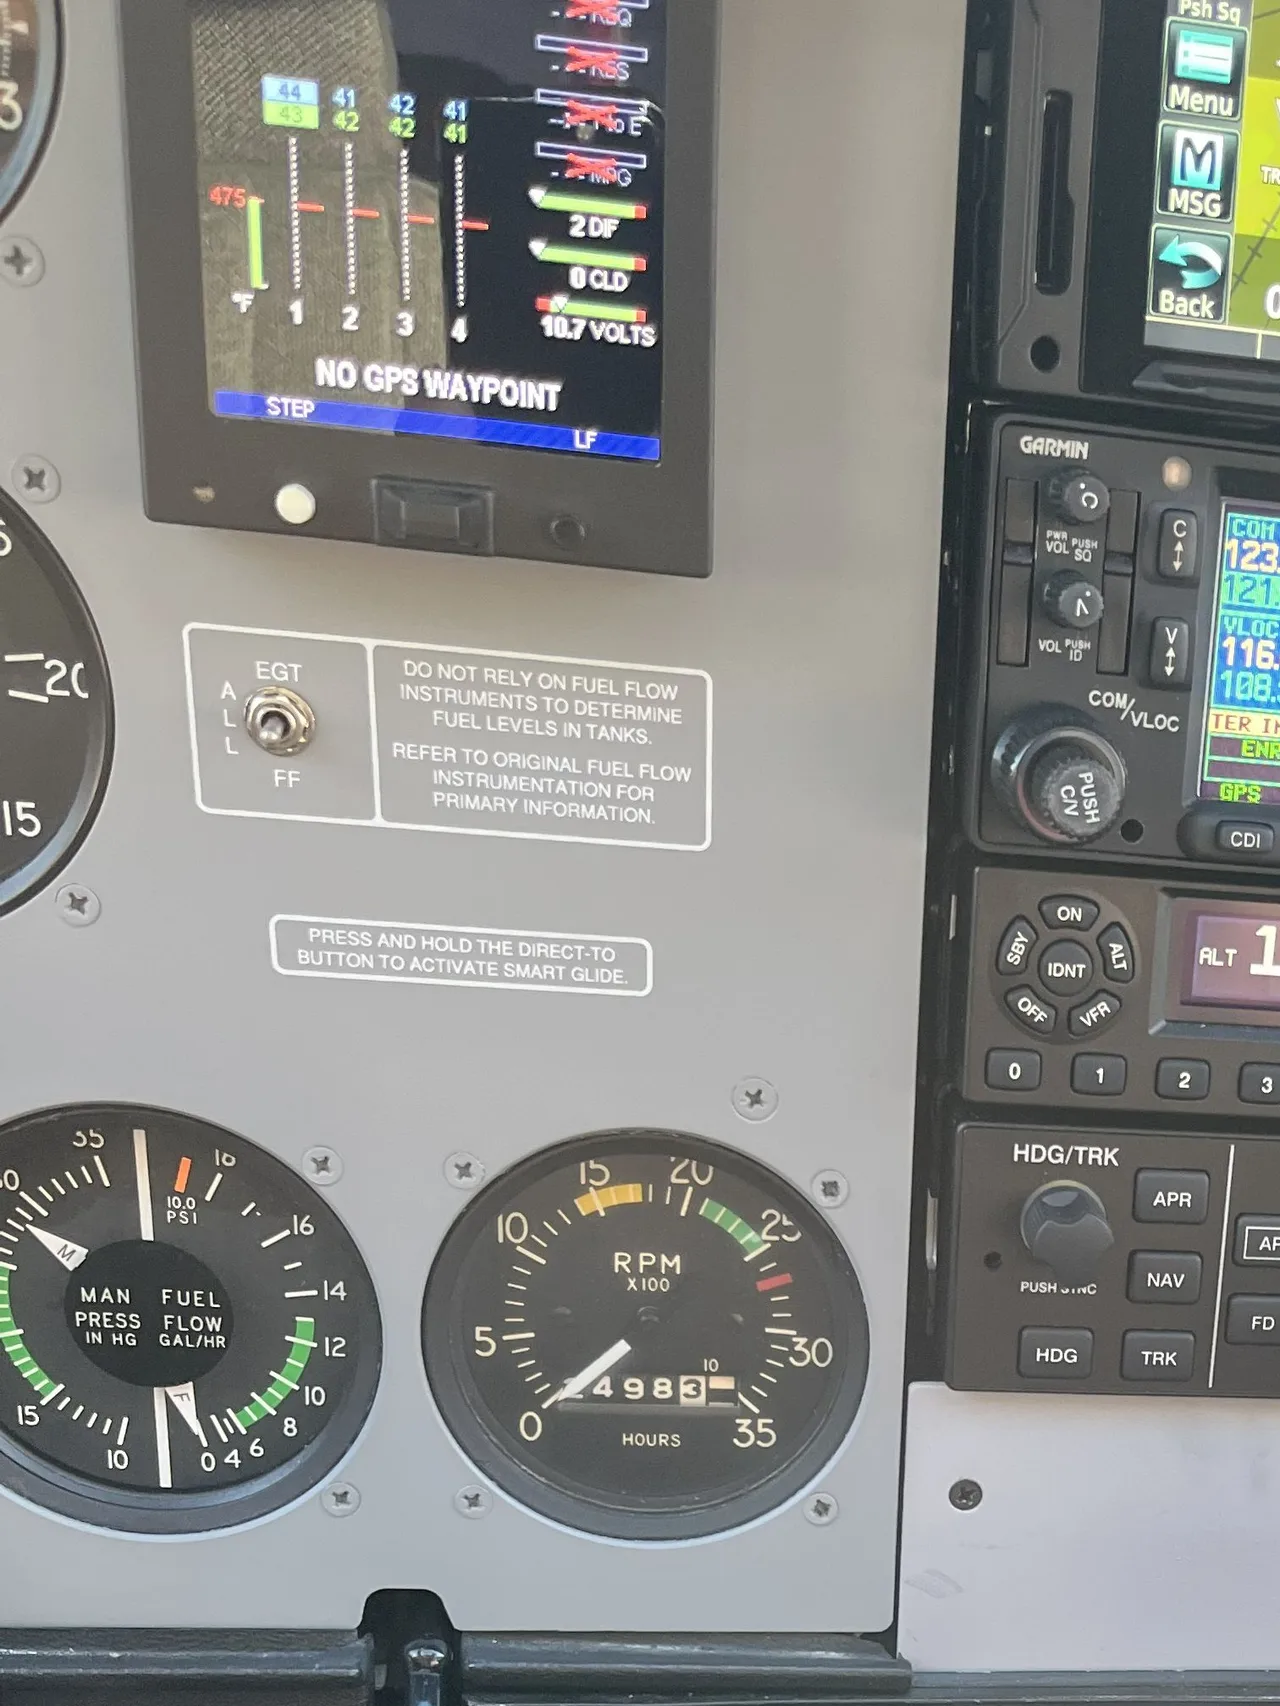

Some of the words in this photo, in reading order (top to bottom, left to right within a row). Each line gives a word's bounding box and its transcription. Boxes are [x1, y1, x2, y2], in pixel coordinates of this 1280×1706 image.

[1169, 85, 1233, 116] Menu
[1168, 189, 1221, 218] MSG
[1159, 291, 1214, 319] Back
[317, 360, 358, 390] NO
[365, 364, 418, 398] GPS
[424, 370, 561, 412] WAYPOINT
[267, 397, 314, 418] STEP
[1020, 435, 1089, 460] GARMIN
[257, 661, 302, 682] EGT
[404, 660, 432, 678] DO
[438, 664, 477, 682] NOT
[484, 668, 532, 688] RELY
[538, 672, 566, 692] ON
[572, 676, 619, 696] FUEL
[624, 681, 678, 701] FLOW
[400, 683, 538, 712] INSTRUMENTS
[542, 696, 568, 714] TO
[574, 699, 682, 724] DETERMINE
[433, 710, 481, 730] FUEL
[487, 715, 558, 736] LEVELS
[564, 722, 581, 738] IN
[587, 724, 652, 745] TANKS.
[1213, 712, 1249, 733] TER
[392, 742, 456, 763] REFER
[460, 748, 488, 766] TO
[494, 750, 582, 774] ORIGINAL
[588, 760, 633, 778] FUEL
[639, 764, 692, 782] FLOW
[433, 770, 610, 798] INSTRUMENTATION
[617, 783, 654, 802] FOR
[1219, 783, 1261, 803] GPS
[433, 792, 518, 814] PRIMARY
[524, 798, 656, 824] INFORMATION.
[1231, 832, 1260, 848] CDI
[1057, 906, 1082, 922] ON
[309, 927, 372, 947] PRESS
[378, 932, 417, 950] AND
[421, 936, 472, 954] HOLD
[477, 939, 513, 956] THE
[518, 941, 616, 963] DIRECT-TO
[1007, 931, 1030, 967] SBY
[298, 949, 374, 969] BUTTON
[378, 954, 405, 971] TO
[410, 957, 499, 976] ACTIVATE
[504, 963, 565, 980] SMART
[571, 967, 629, 985] GLIDE.
[1199, 946, 1237, 967] ALT
[1047, 963, 1086, 979] IDNT
[1079, 1000, 1111, 1028] VFR
[1013, 1143, 1120, 1167] HDG/TRK
[1153, 1191, 1192, 1209] APR
[613, 1252, 682, 1275] RPM
[627, 1277, 670, 1293] X100
[1147, 1273, 1185, 1289] NAV
[81, 1287, 130, 1304] MAN
[162, 1289, 220, 1309] FUEL
[75, 1312, 141, 1330] PRESS
[164, 1314, 222, 1332] FLOW
[159, 1334, 226, 1349] GAL/HR
[1035, 1347, 1078, 1364] HDG
[1141, 1351, 1177, 1366] TRK
[623, 1433, 681, 1447] HOURS
